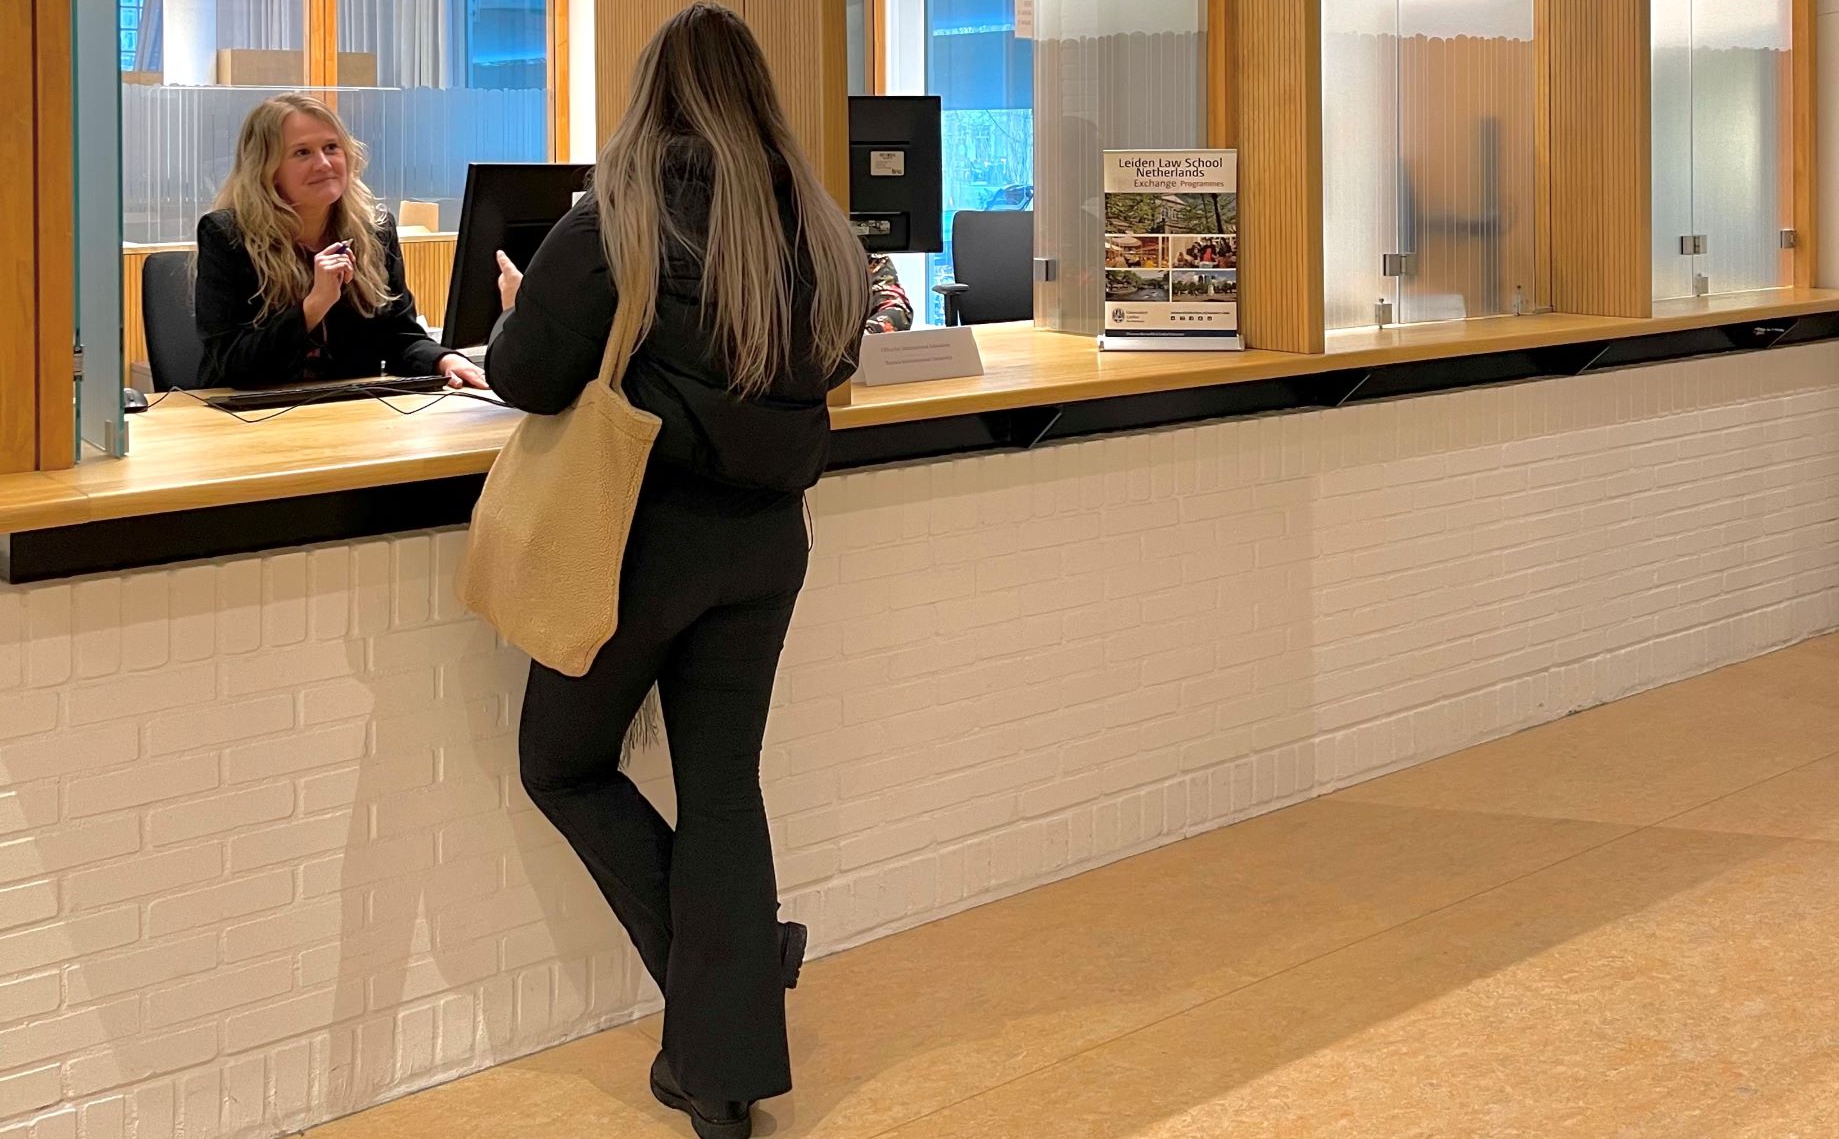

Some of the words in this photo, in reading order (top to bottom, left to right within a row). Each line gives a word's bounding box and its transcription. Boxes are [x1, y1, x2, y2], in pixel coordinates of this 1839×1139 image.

[1118, 157, 1155, 168] Leiden
[1158, 158, 1182, 168] Law
[1184, 157, 1223, 168] School
[1136, 167, 1205, 178] Netherlands
[1133, 179, 1177, 190] Exchange
[1180, 180, 1225, 189] Programmes
